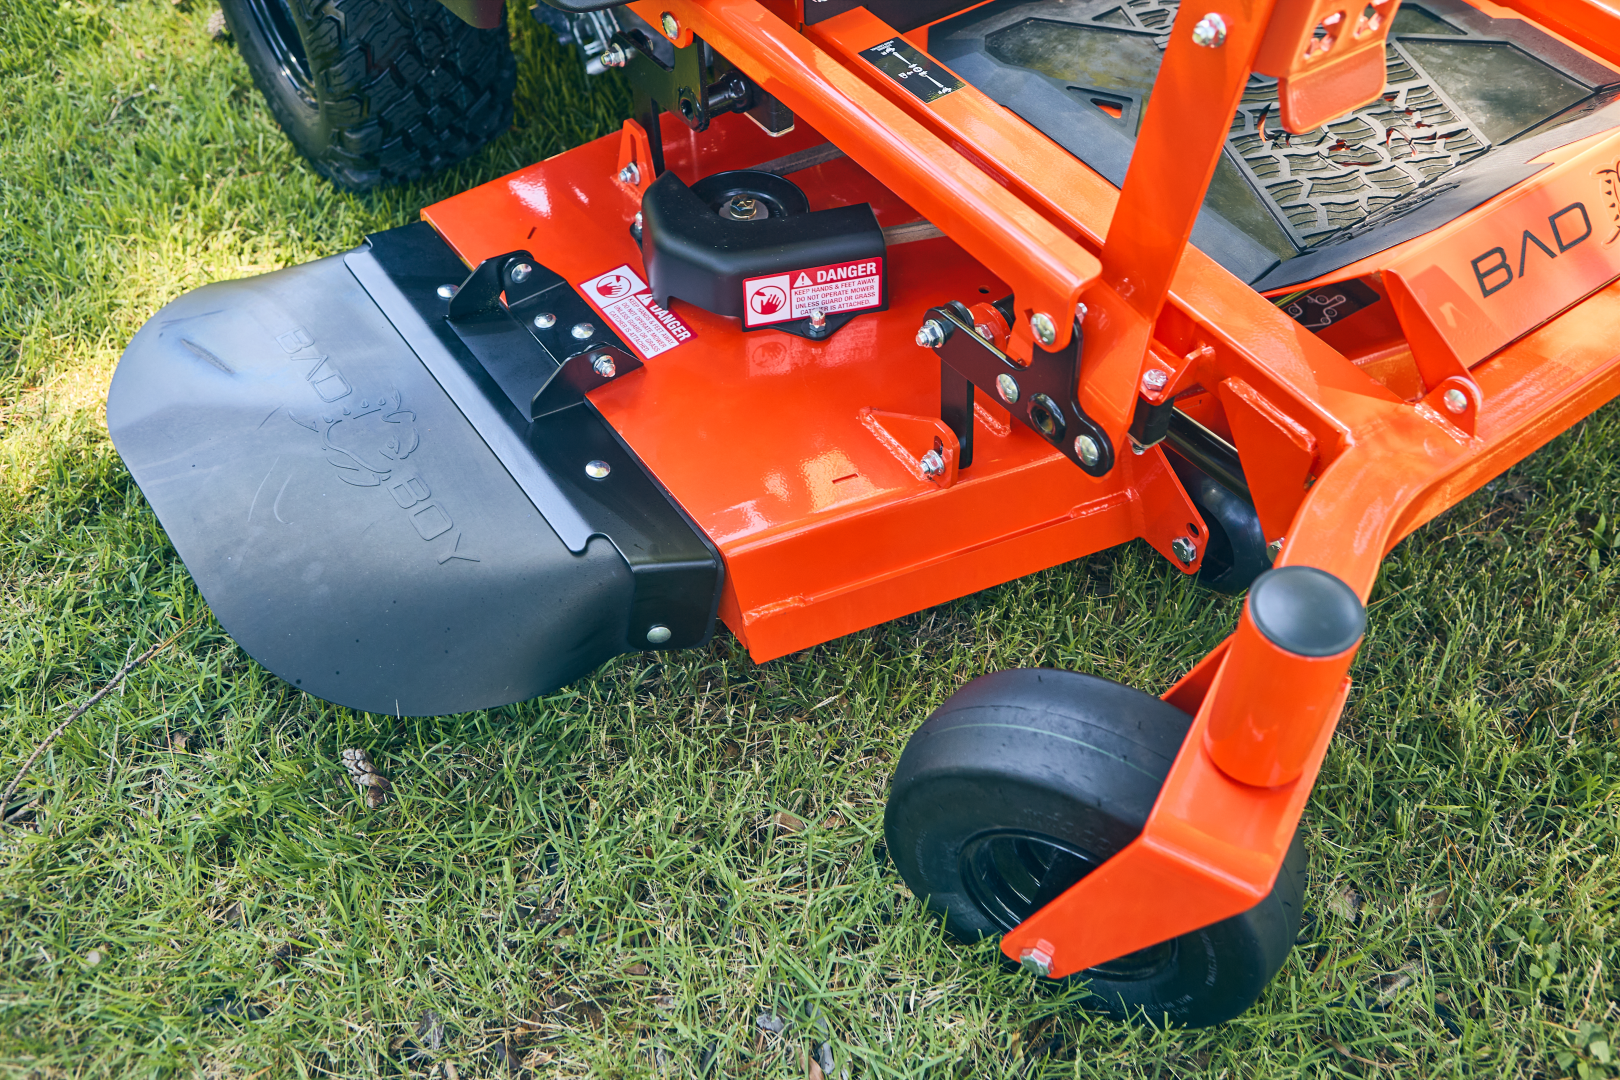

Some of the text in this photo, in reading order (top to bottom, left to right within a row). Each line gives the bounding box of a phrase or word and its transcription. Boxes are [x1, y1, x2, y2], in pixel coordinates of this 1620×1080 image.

[1470, 202, 1592, 298] BAD
[812, 285, 833, 293] HANDS
[817, 262, 876, 283] DANGER
[821, 289, 848, 299] OPERATE
[851, 285, 874, 294] MOWER
[796, 301, 819, 310] UNLESS
[822, 297, 842, 305] GUARD
[855, 291, 875, 300] GRASS
[801, 306, 828, 315] CATER
[838, 299, 870, 309] ATTACHED.
[608, 311, 628, 328] CATCHER
[628, 332, 651, 353] ATTACHED.
[613, 305, 631, 320] UNLESS
[626, 319, 643, 333] GUARD
[644, 338, 661, 352] GRASS
[627, 298, 640, 308] KEEP
[636, 307, 652, 321] HANDS
[652, 324, 665, 334] FEET
[661, 333, 676, 345] AWAY.
[627, 308, 638, 316] NOT
[634, 316, 654, 333] OPERATE
[650, 332, 668, 348] MOWER
[649, 304, 692, 342] DANGER
[275, 325, 352, 403] BAD
[387, 472, 480, 565] BOY
